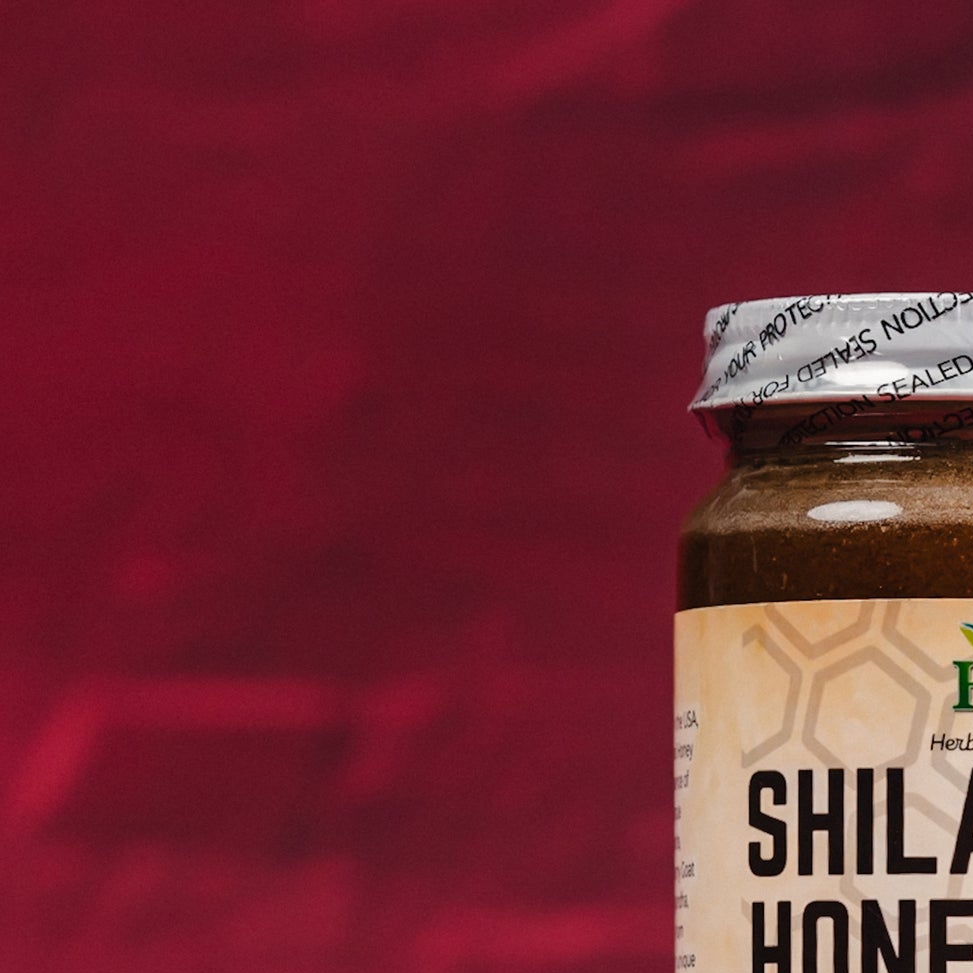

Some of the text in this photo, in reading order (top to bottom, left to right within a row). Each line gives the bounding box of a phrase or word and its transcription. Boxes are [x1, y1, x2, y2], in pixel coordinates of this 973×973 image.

[759, 294, 841, 351] PROTEC
[797, 328, 877, 382] SEALED
[752, 375, 790, 407] FOR
